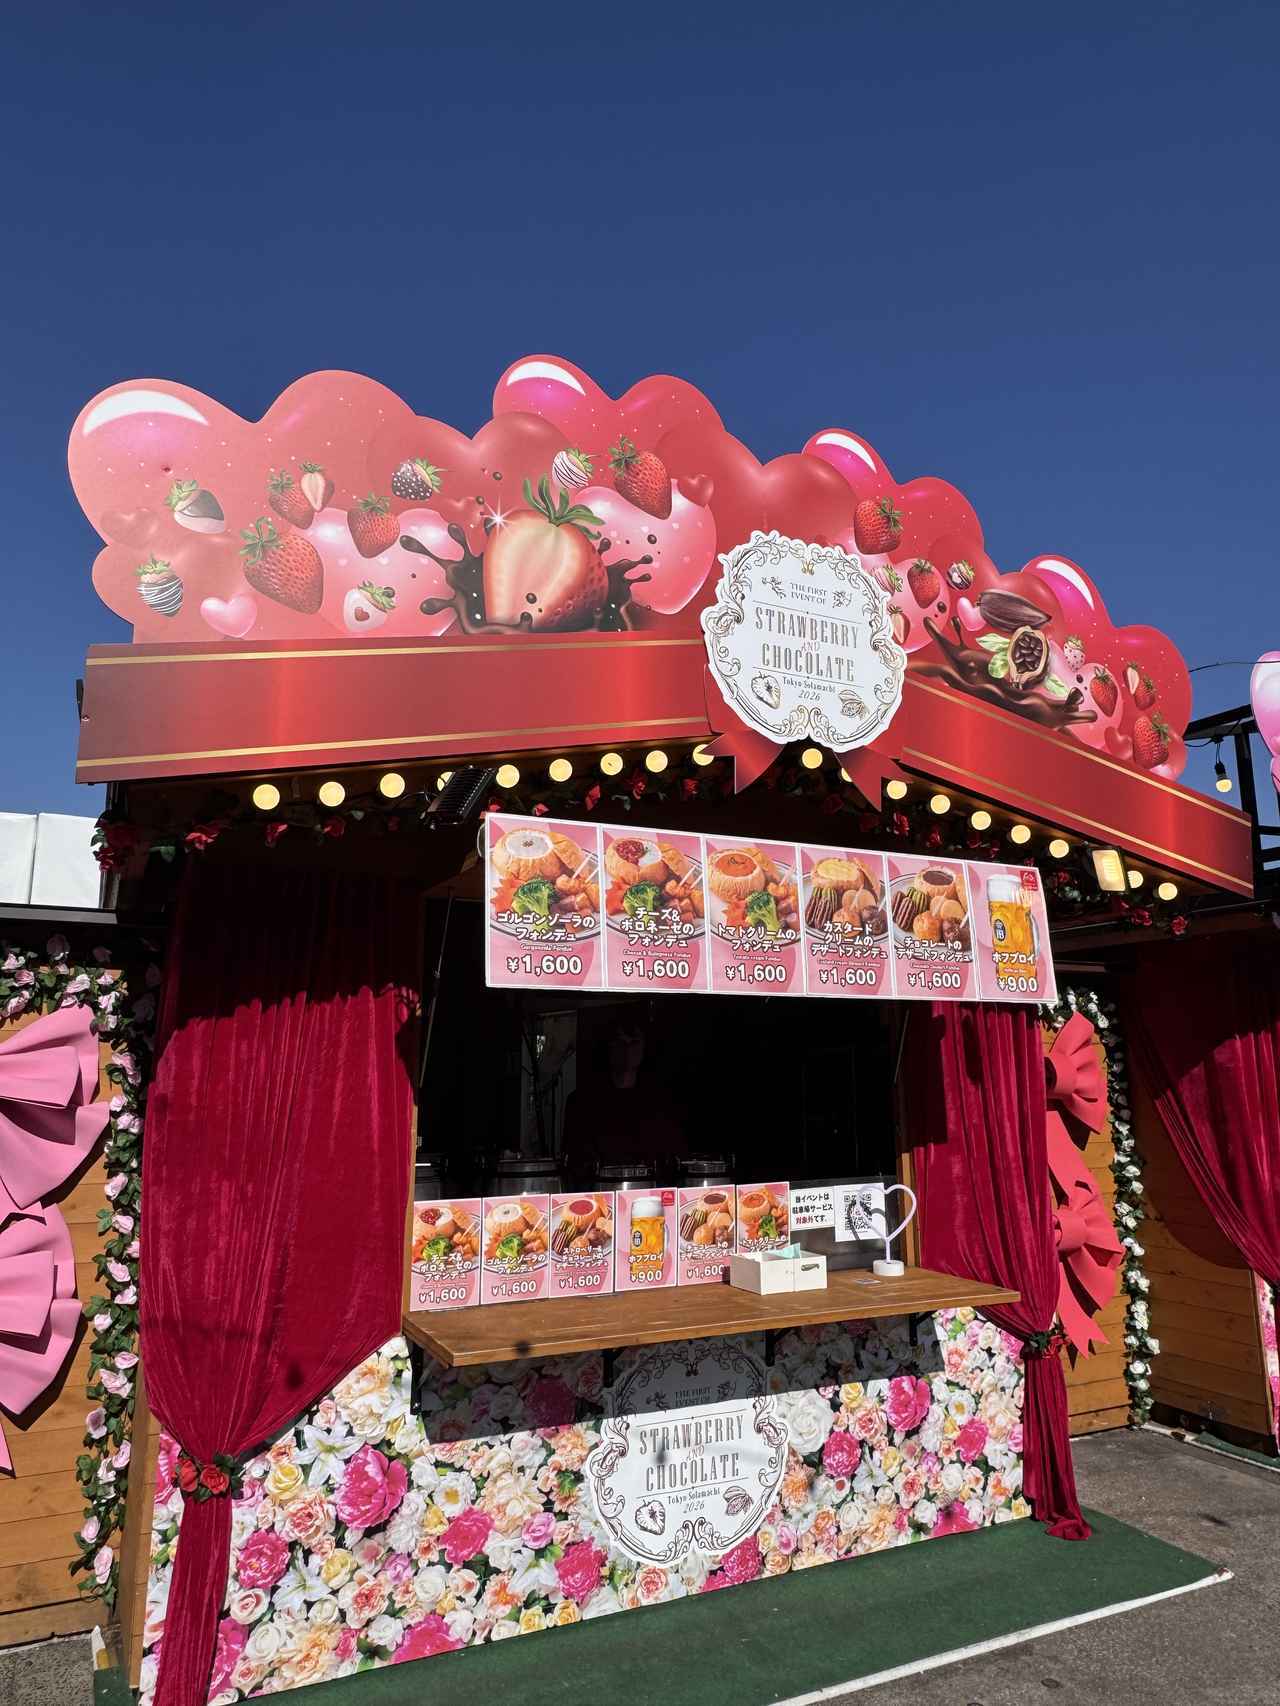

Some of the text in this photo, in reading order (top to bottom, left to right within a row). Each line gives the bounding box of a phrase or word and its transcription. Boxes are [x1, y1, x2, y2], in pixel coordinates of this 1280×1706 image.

[790, 582, 828, 597] THE FIRST
[790, 591, 826, 605] EVENT OF
[755, 606, 859, 649] STRAWBERRY
[801, 641, 820, 652] AND
[762, 642, 855, 682] CHOCOLATE
[782, 676, 802, 689] Tokyo
[798, 690, 821, 701] 2026
[497, 911, 595, 928] ゴルゴンゾーラの
[635, 906, 681, 921] チーズ&
[516, 927, 576, 941] フォンデュ
[621, 918, 695, 935] ボロネーゼの
[718, 923, 796, 940] トマトクリームの
[823, 921, 873, 936] カスタード
[628, 933, 689, 948] フォンデュ
[732, 939, 781, 952] フォンデュ
[824, 934, 874, 948] クリームの
[904, 936, 962, 950] チョコレートの
[811, 943, 888, 959] デザートフォンデュ
[896, 948, 969, 962] デザートフォンデュ
[506, 954, 582, 976] ¥1,600
[622, 958, 689, 980] ¥1,600
[725, 963, 786, 984] ¥1,600
[819, 966, 876, 986] ¥1,600
[908, 970, 960, 990] ¥1,600
[998, 977, 1038, 992] ¥900
[559, 1274, 601, 1289] ¥1,600
[631, 1270, 662, 1282] ¥900
[492, 1280, 536, 1296] ¥1,600
[419, 1288, 466, 1304] ¥1,600
[640, 1415, 743, 1455] STRAWBERRY
[646, 1453, 739, 1491] CHOCOLATE
[668, 1496, 687, 1505] Tokyo
